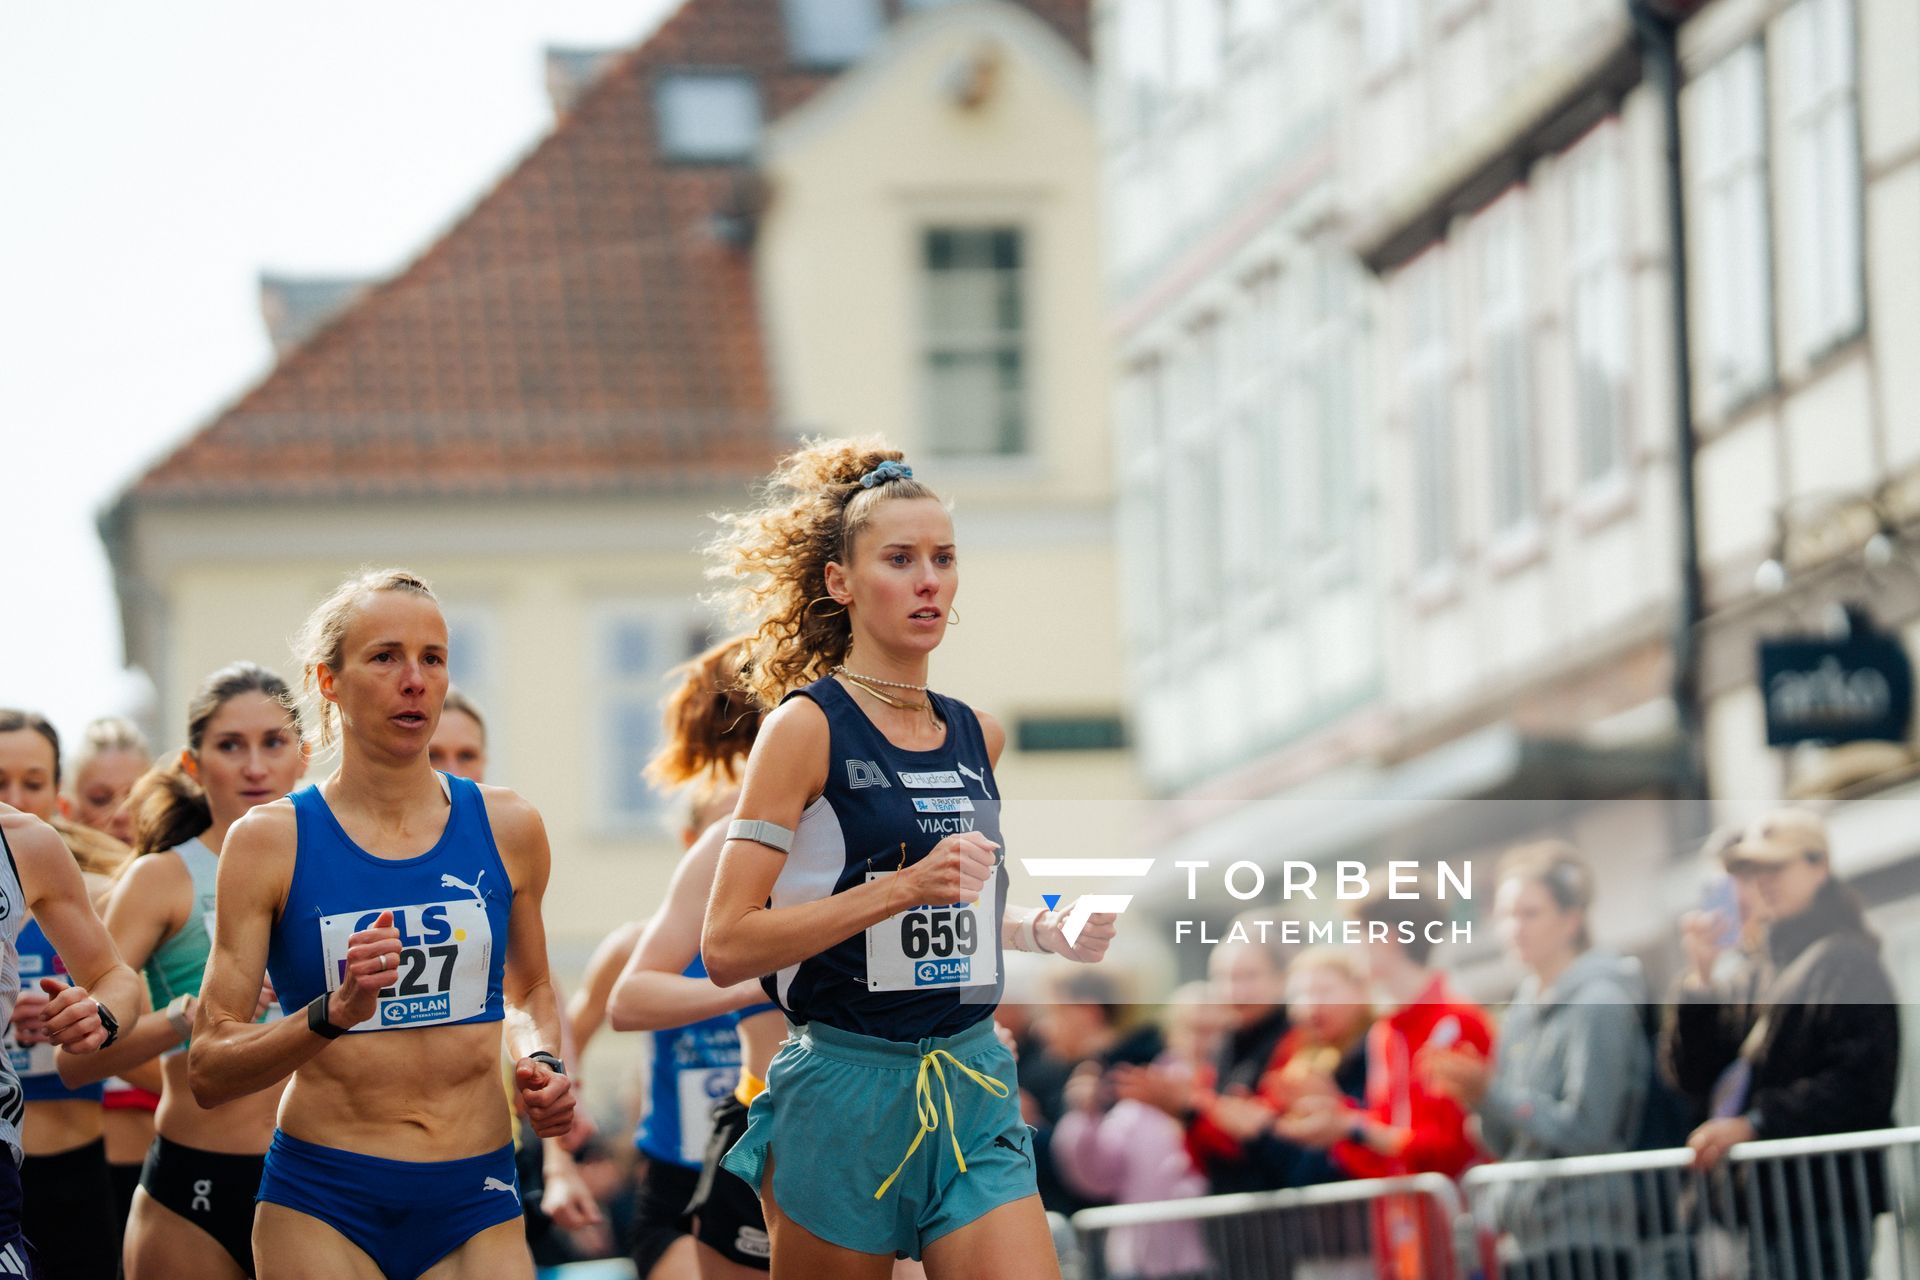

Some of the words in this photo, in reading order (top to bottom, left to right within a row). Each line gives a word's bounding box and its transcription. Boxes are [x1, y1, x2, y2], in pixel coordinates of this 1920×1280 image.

[916, 818, 975, 834] VIACTIV
[901, 909, 978, 959] 659
[378, 944, 458, 998] 27
[940, 962, 969, 975] PLAN
[410, 998, 447, 1013] PLAN
